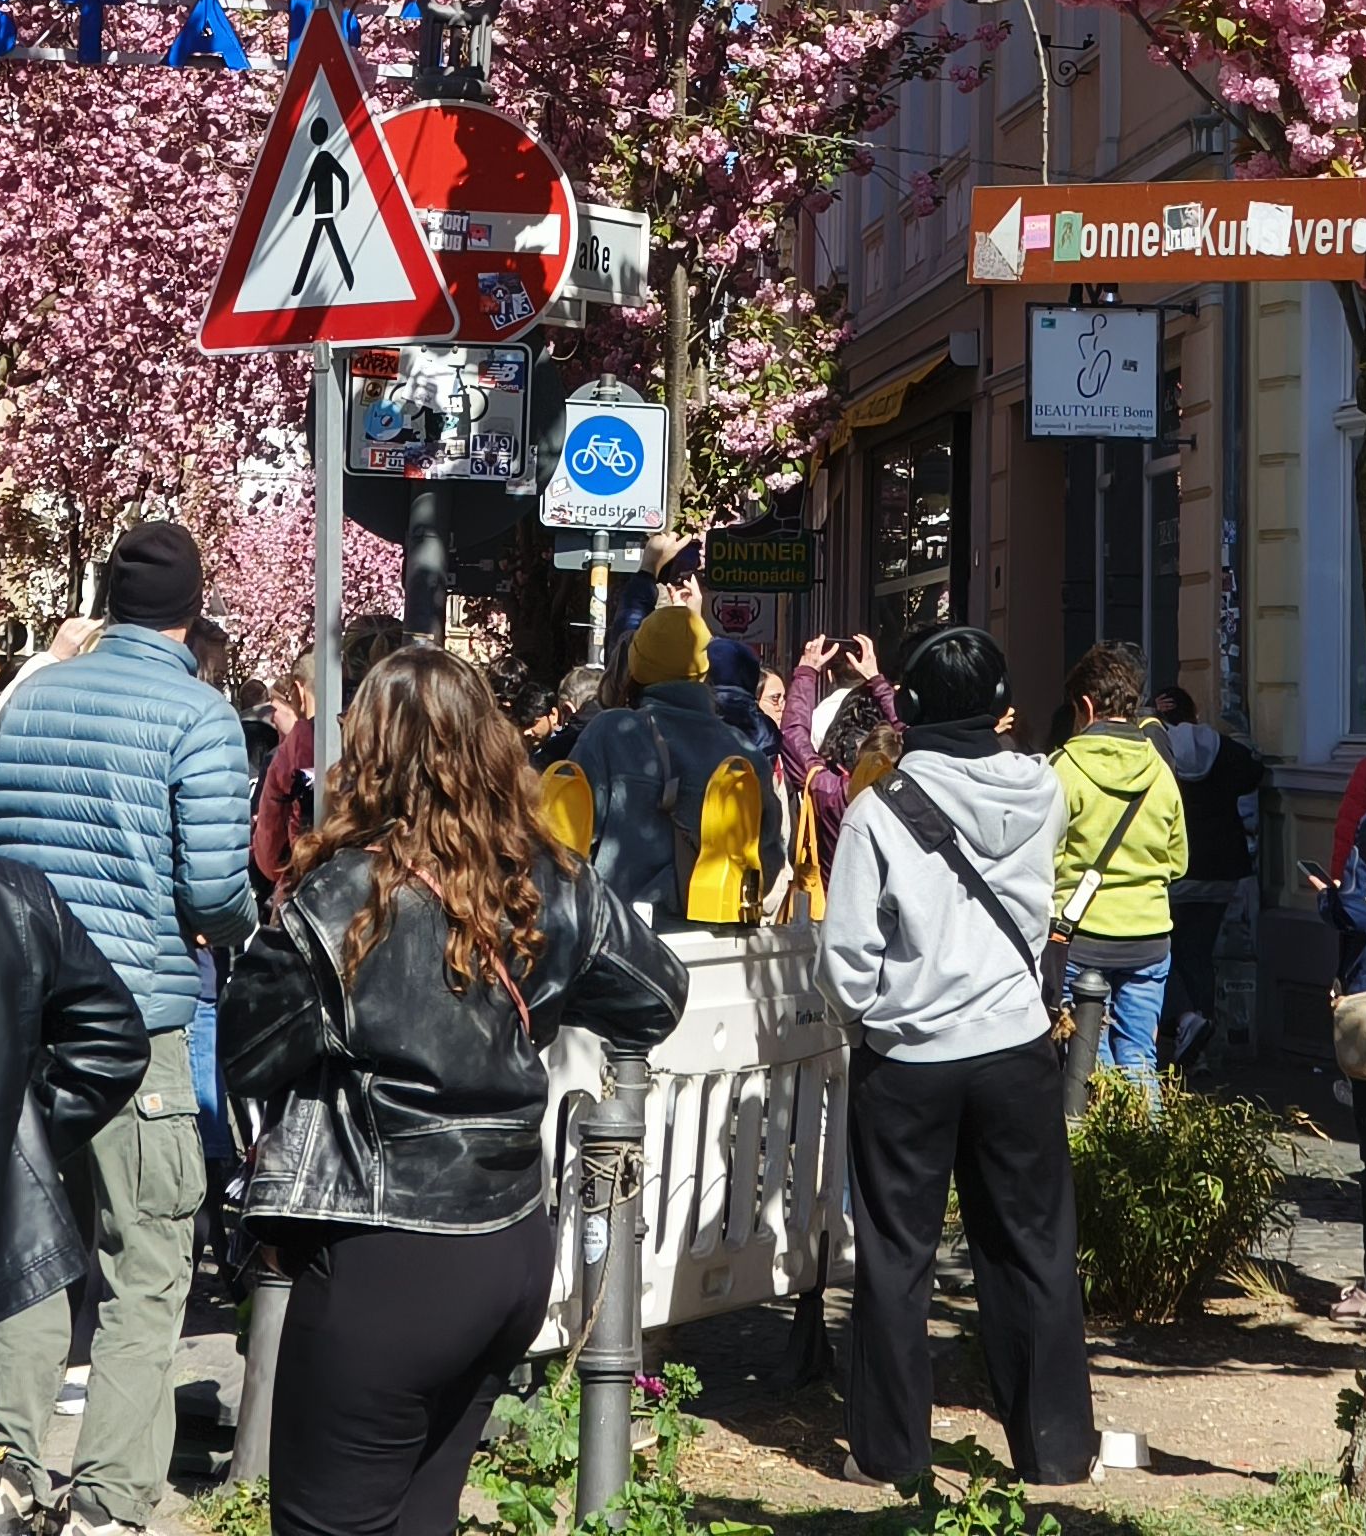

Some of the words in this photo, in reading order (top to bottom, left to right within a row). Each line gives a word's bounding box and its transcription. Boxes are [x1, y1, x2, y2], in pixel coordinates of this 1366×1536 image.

[427, 211, 470, 232] SPORT
[1059, 219, 1168, 257] onne
[1035, 405, 1120, 418] BEAUTYLIFE
[1124, 406, 1154, 419] Bonn
[711, 542, 807, 562] DINTNER
